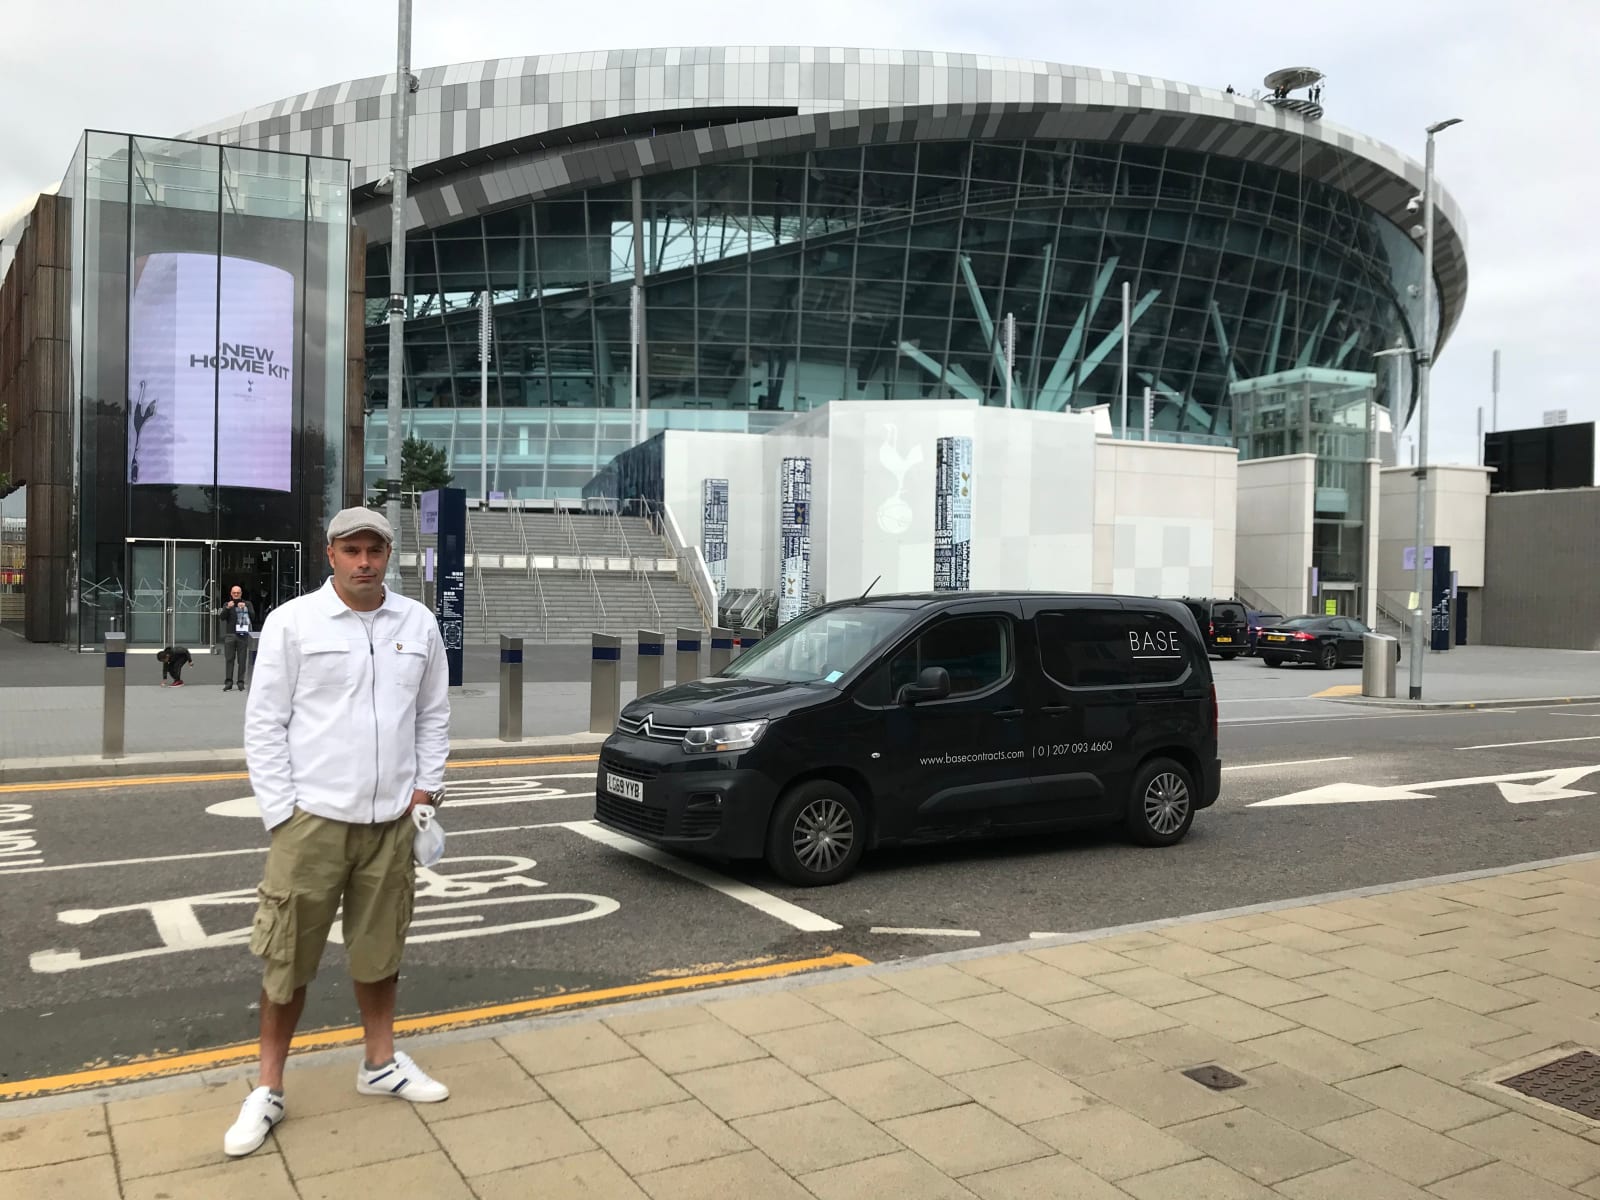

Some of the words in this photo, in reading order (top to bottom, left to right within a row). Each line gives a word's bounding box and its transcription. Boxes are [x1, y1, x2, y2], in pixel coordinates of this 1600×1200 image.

[222, 342, 274, 362] NEW
[190, 354, 265, 375] HOME
[268, 363, 290, 380] KIT
[1128, 630, 1181, 651] BASE
[919, 749, 1025, 766] www.basecontracts.com
[1090, 740, 1113, 752] 4660
[625, 780, 641, 799] YYB
